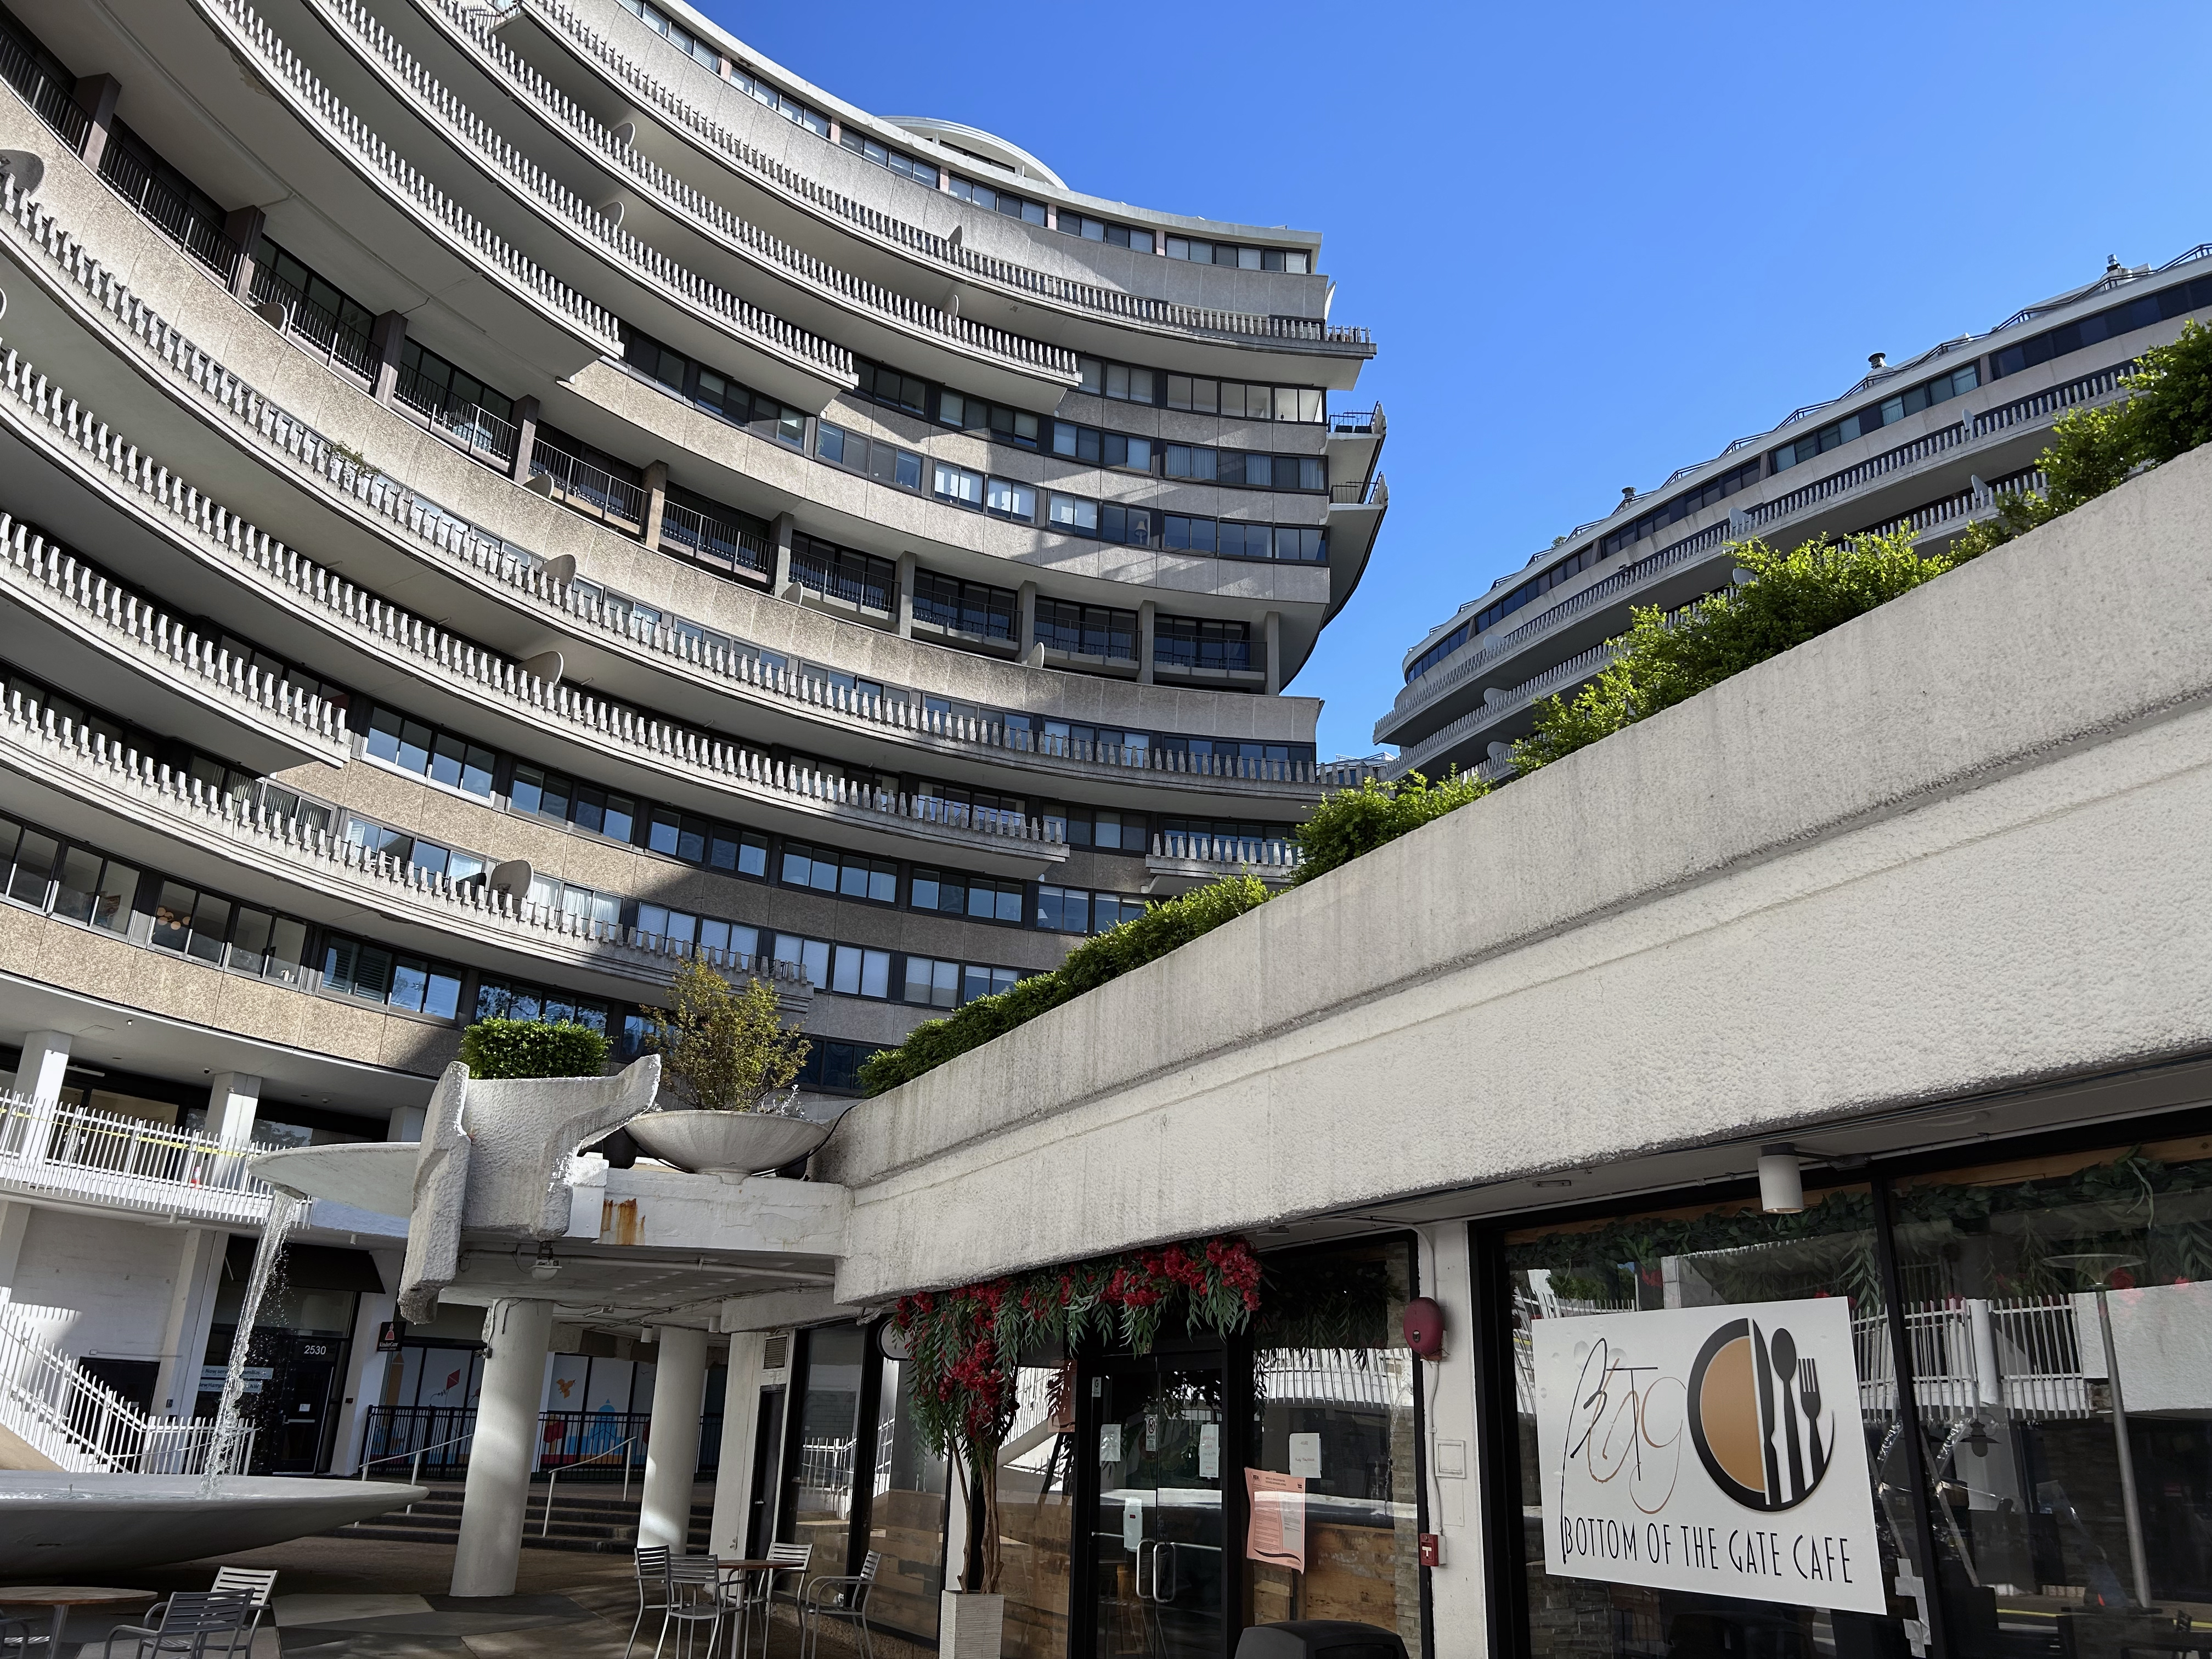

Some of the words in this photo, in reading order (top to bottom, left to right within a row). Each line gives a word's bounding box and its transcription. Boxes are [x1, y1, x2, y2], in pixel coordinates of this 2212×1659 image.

[304, 1345, 326, 1355] 2530
[1094, 1379, 1099, 1388] G
[1564, 1516, 1637, 1561] BOTTOM
[1647, 1522, 1671, 1565] OF
[1680, 1525, 1719, 1570] THE
[1729, 1530, 1782, 1577] GATE
[1793, 1534, 1853, 1584] CAFE
